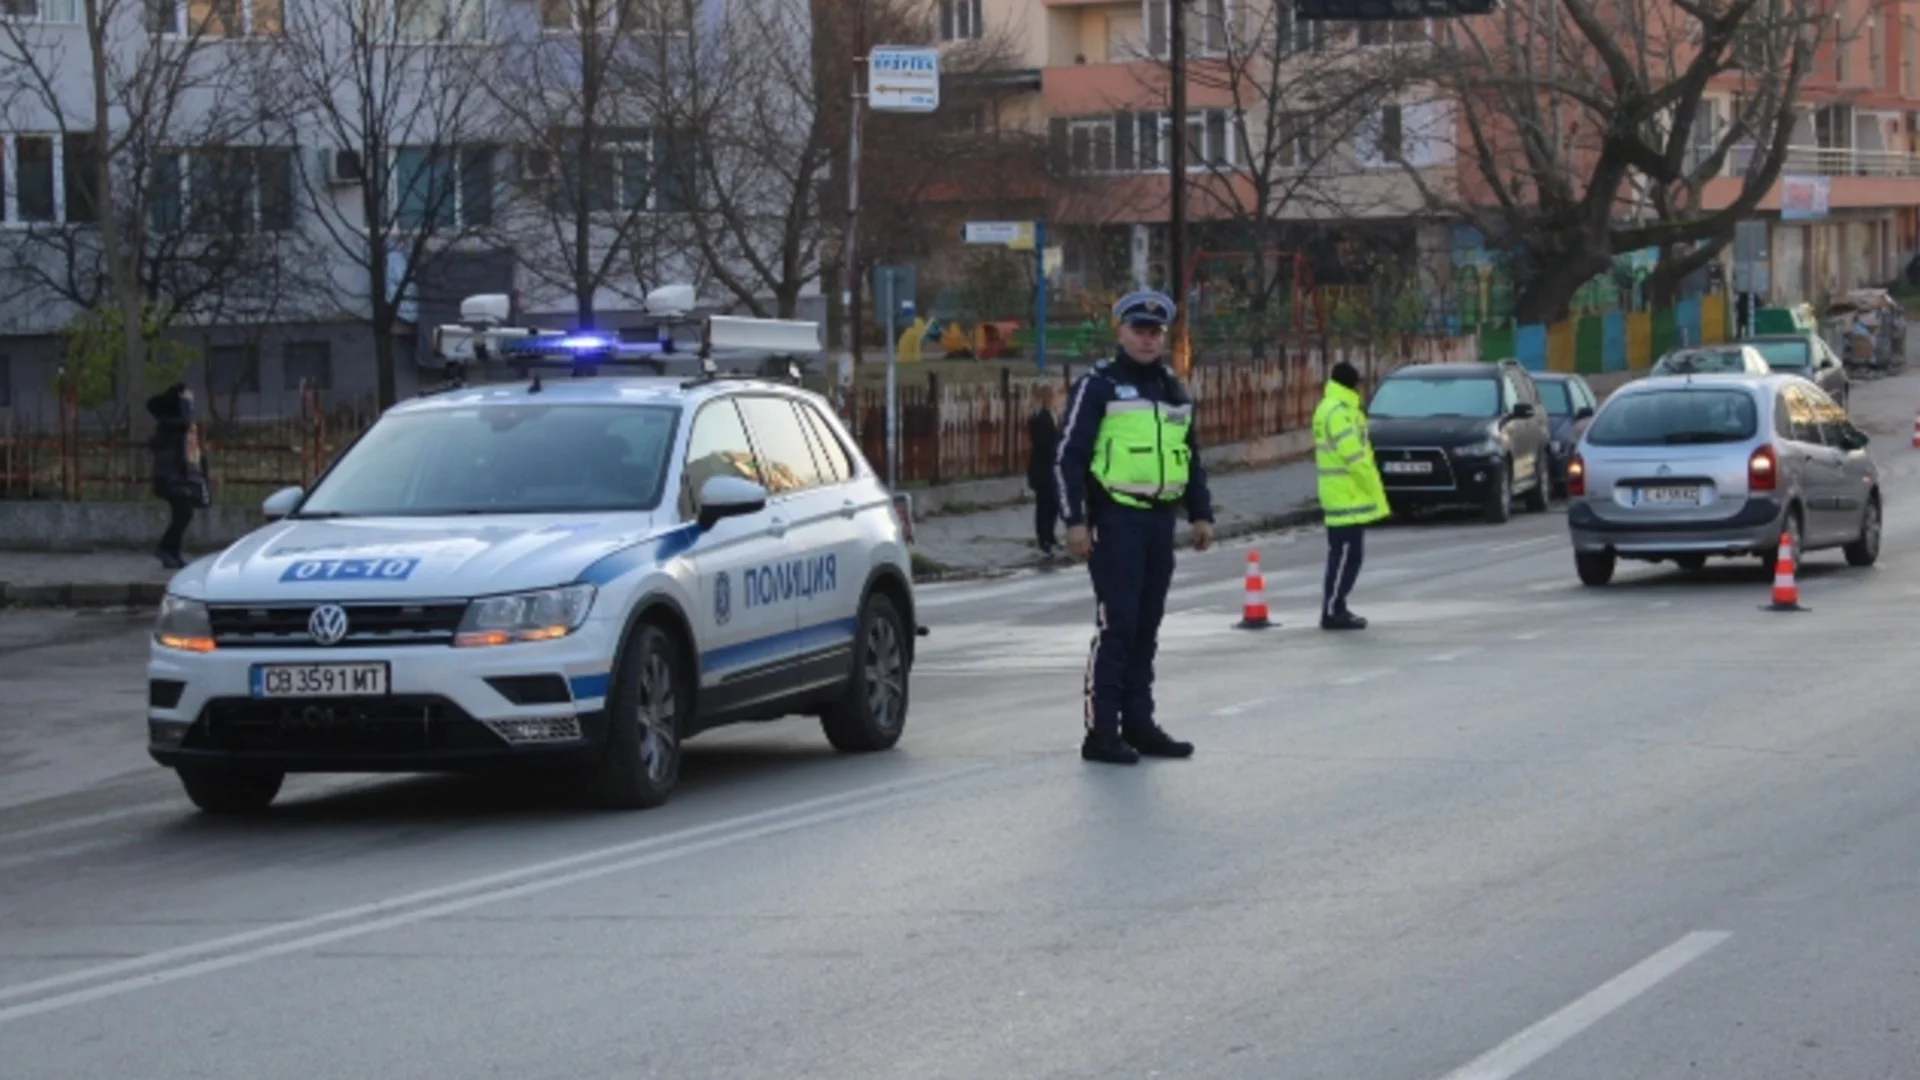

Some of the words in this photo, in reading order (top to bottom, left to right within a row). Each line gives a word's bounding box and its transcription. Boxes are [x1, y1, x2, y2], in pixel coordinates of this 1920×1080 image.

[296, 559, 410, 579] 01-10
[744, 553, 836, 609] ПОЛИЦИЯ
[296, 667, 348, 692] 3591
